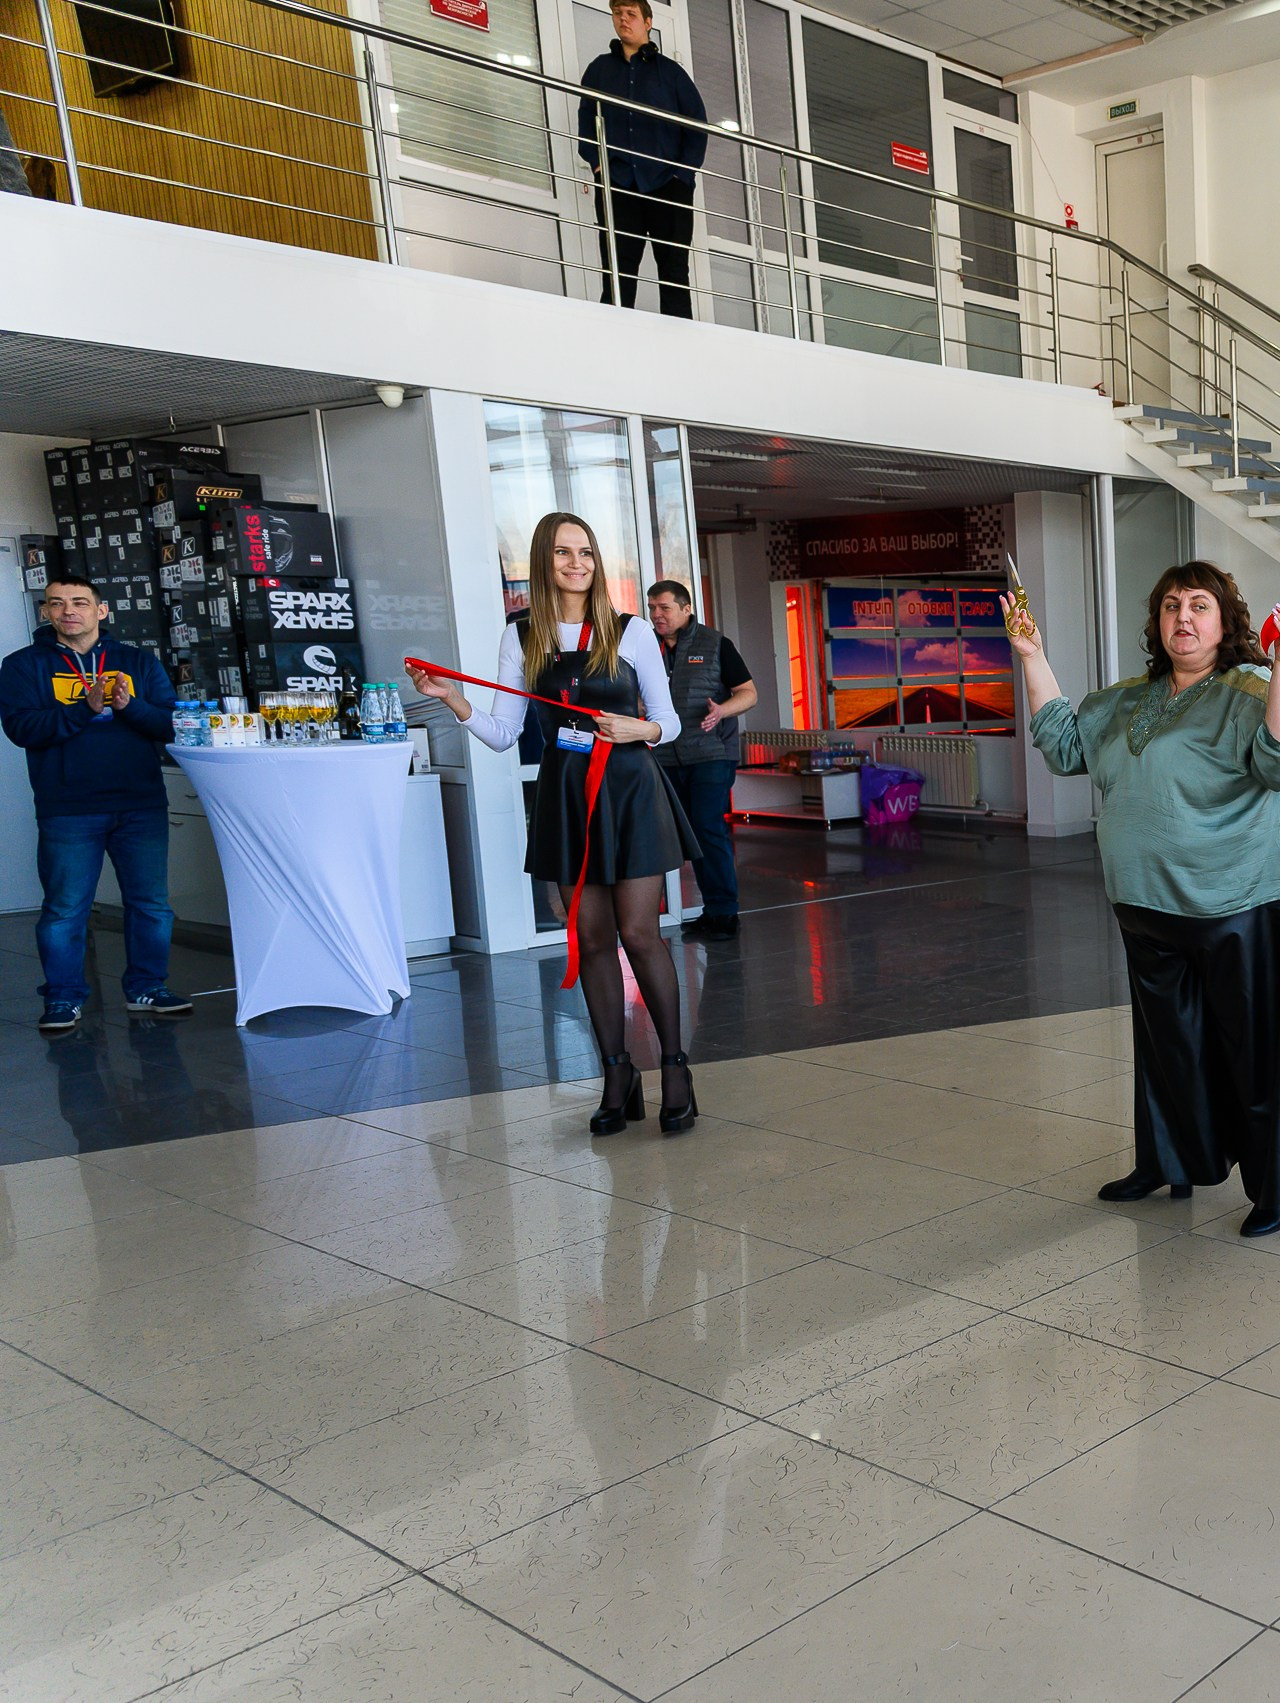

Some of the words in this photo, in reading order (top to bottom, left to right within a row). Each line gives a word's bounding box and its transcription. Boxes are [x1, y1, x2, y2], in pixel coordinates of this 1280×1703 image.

[1110, 102, 1136, 117] ВЫХОД
[180, 446, 221, 455] ACERBIS
[199, 488, 239, 497] Klim
[243, 514, 267, 572] starks
[262, 528, 270, 544] ride
[806, 538, 859, 556] СПАСИБО
[863, 537, 878, 553] ЗА
[880, 535, 908, 552] ВАШ
[911, 532, 959, 551] ВЫБОР!
[264, 544, 272, 560] safe
[269, 591, 352, 610] SPARX
